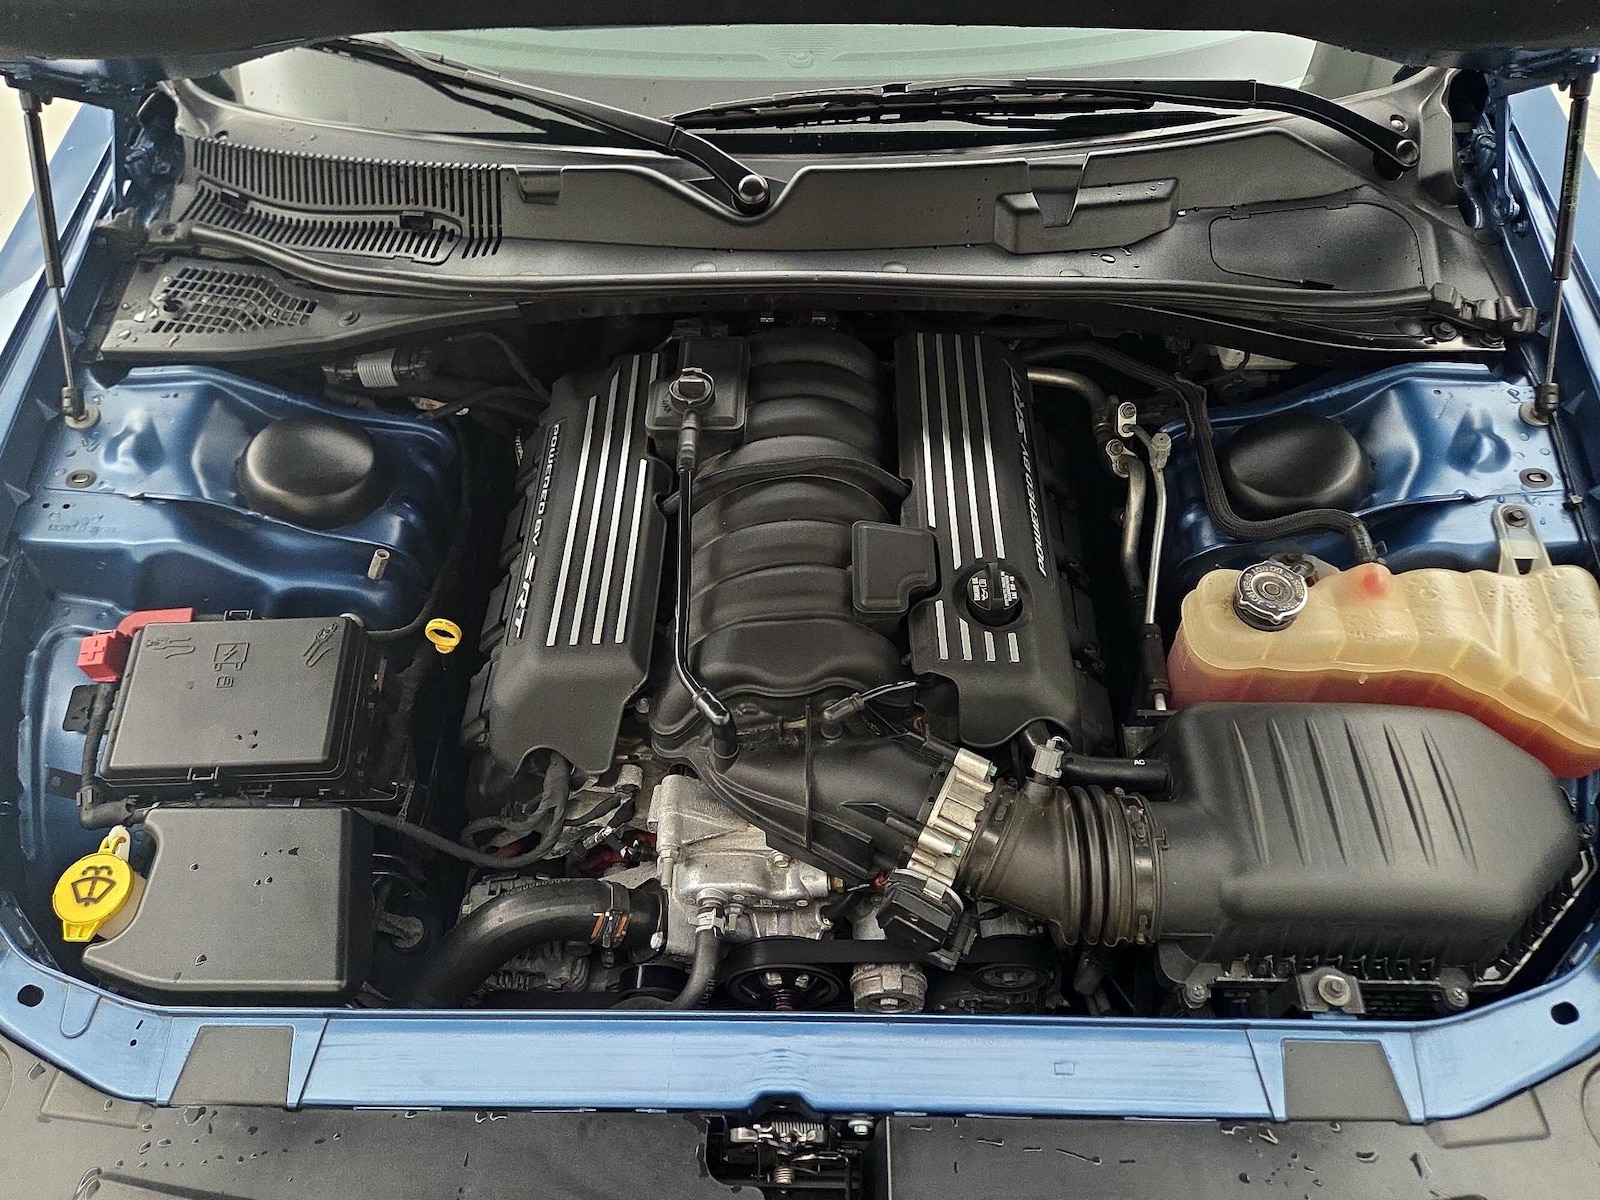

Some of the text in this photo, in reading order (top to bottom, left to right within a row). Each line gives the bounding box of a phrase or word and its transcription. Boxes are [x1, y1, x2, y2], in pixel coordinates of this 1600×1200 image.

[514, 423, 560, 639] POWERED BY SRT
[1010, 366, 1047, 578] POWERED BY SRT
